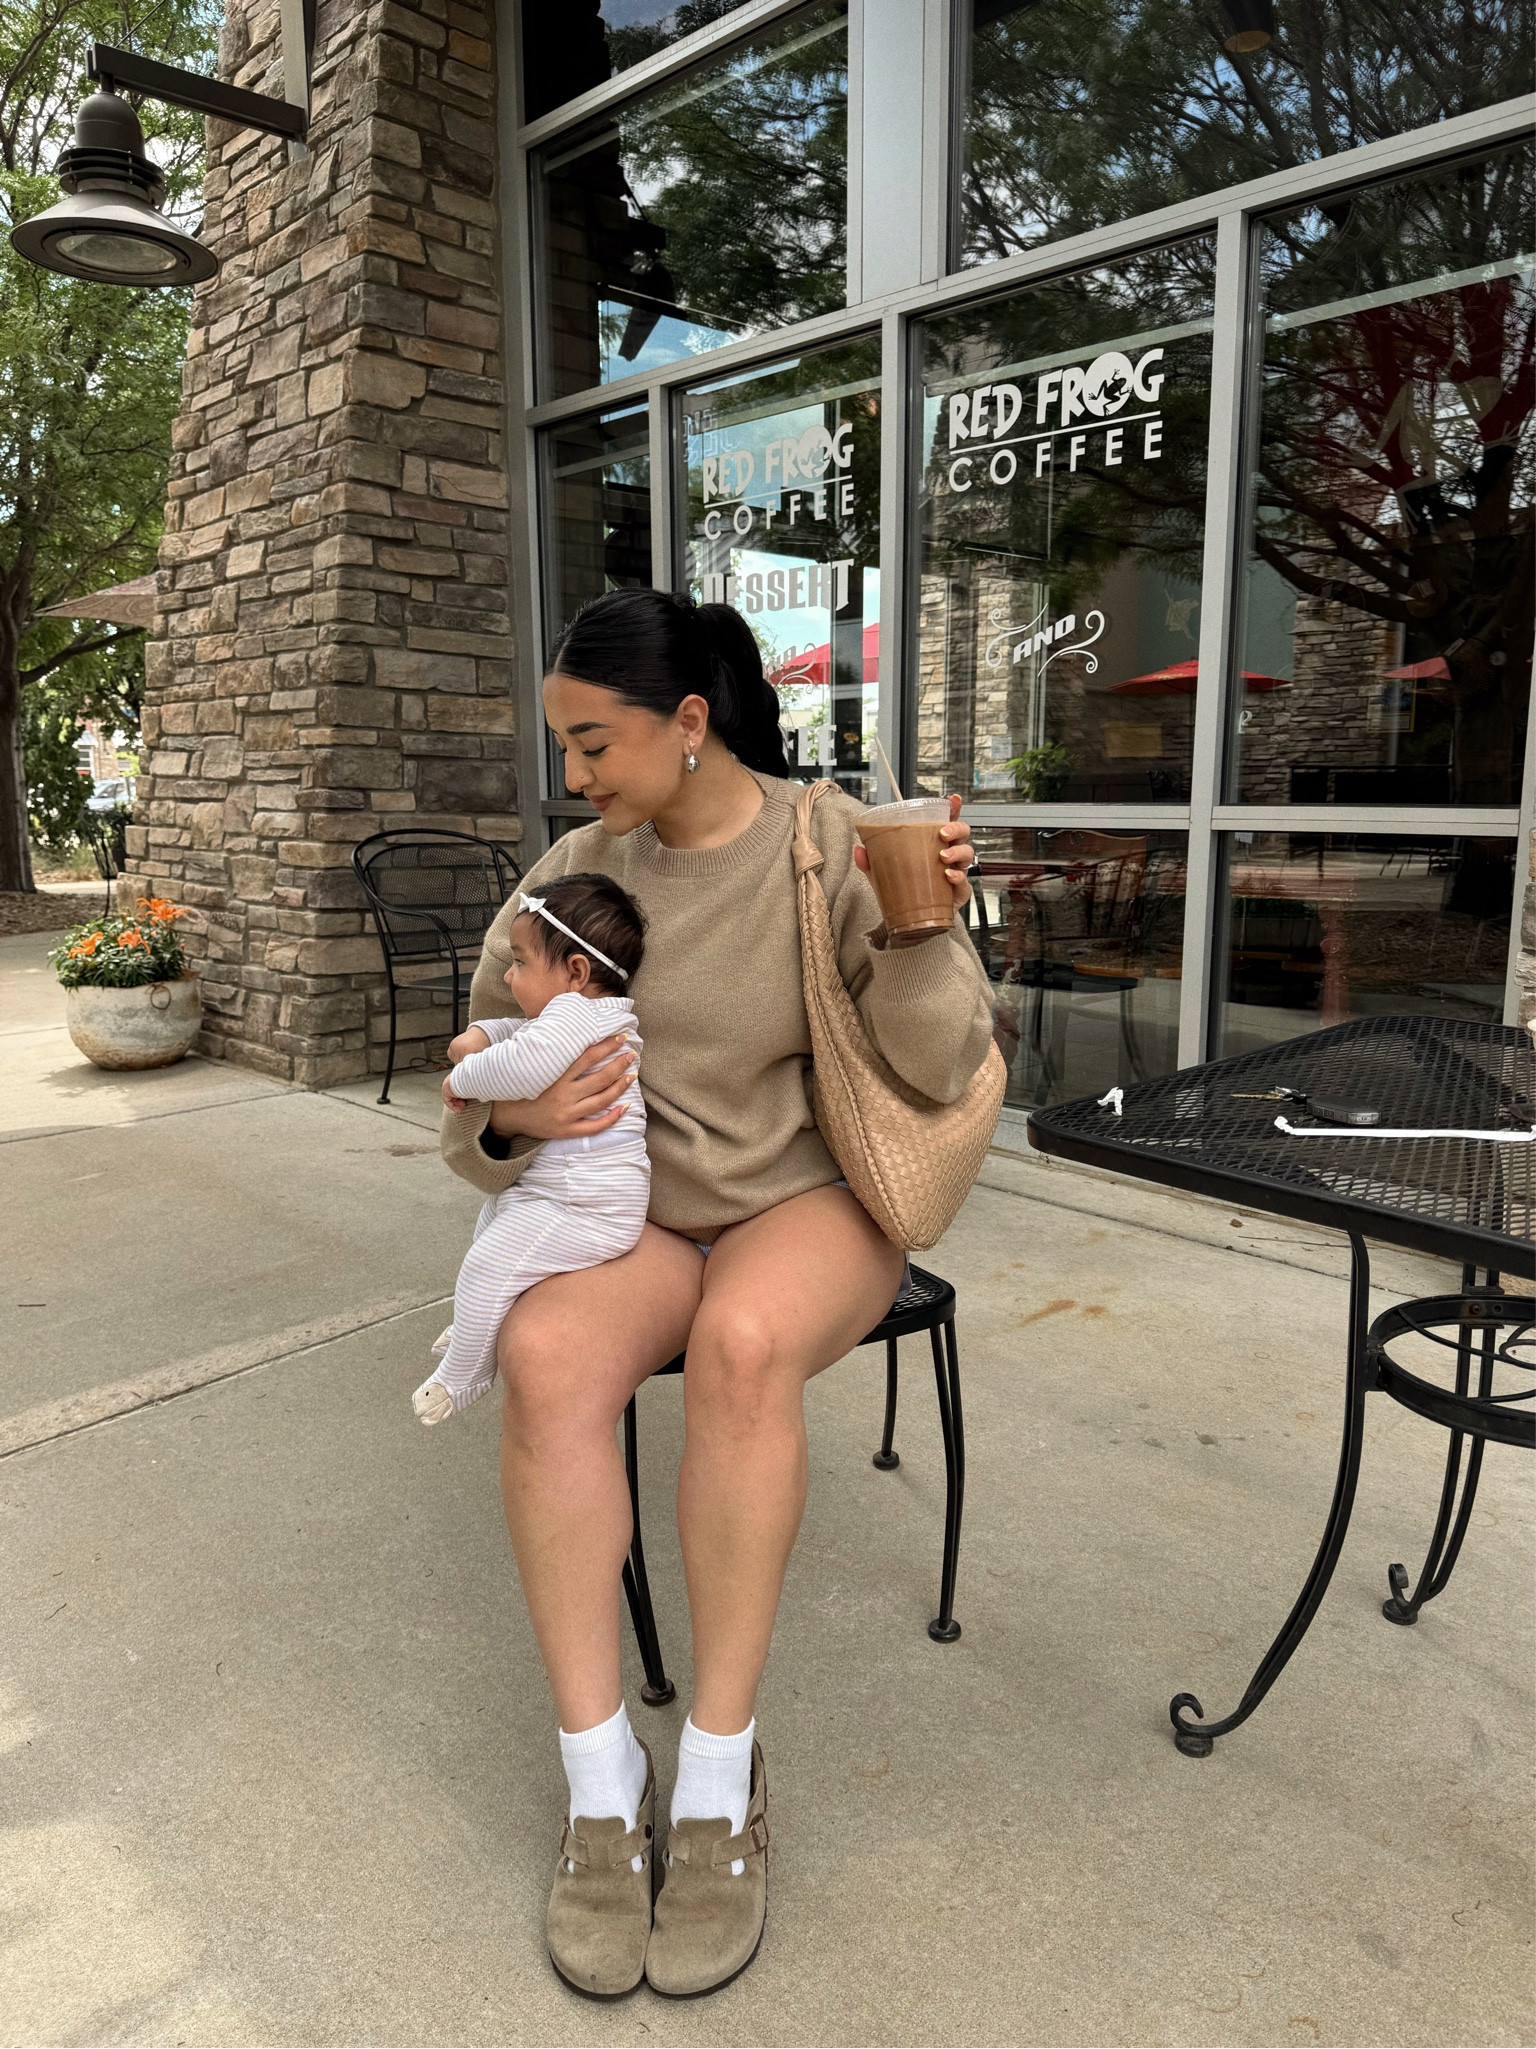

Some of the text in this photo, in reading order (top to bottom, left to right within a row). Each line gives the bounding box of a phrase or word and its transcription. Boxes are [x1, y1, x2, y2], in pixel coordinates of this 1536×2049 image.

[949, 348, 1165, 449] RED FROG
[702, 450, 755, 504] RED
[765, 422, 855, 488] FROG
[949, 420, 1163, 492] COFFEE
[704, 483, 855, 541] COFFEE
[702, 558, 855, 614] DESSERT
[1012, 613, 1076, 664] AND
